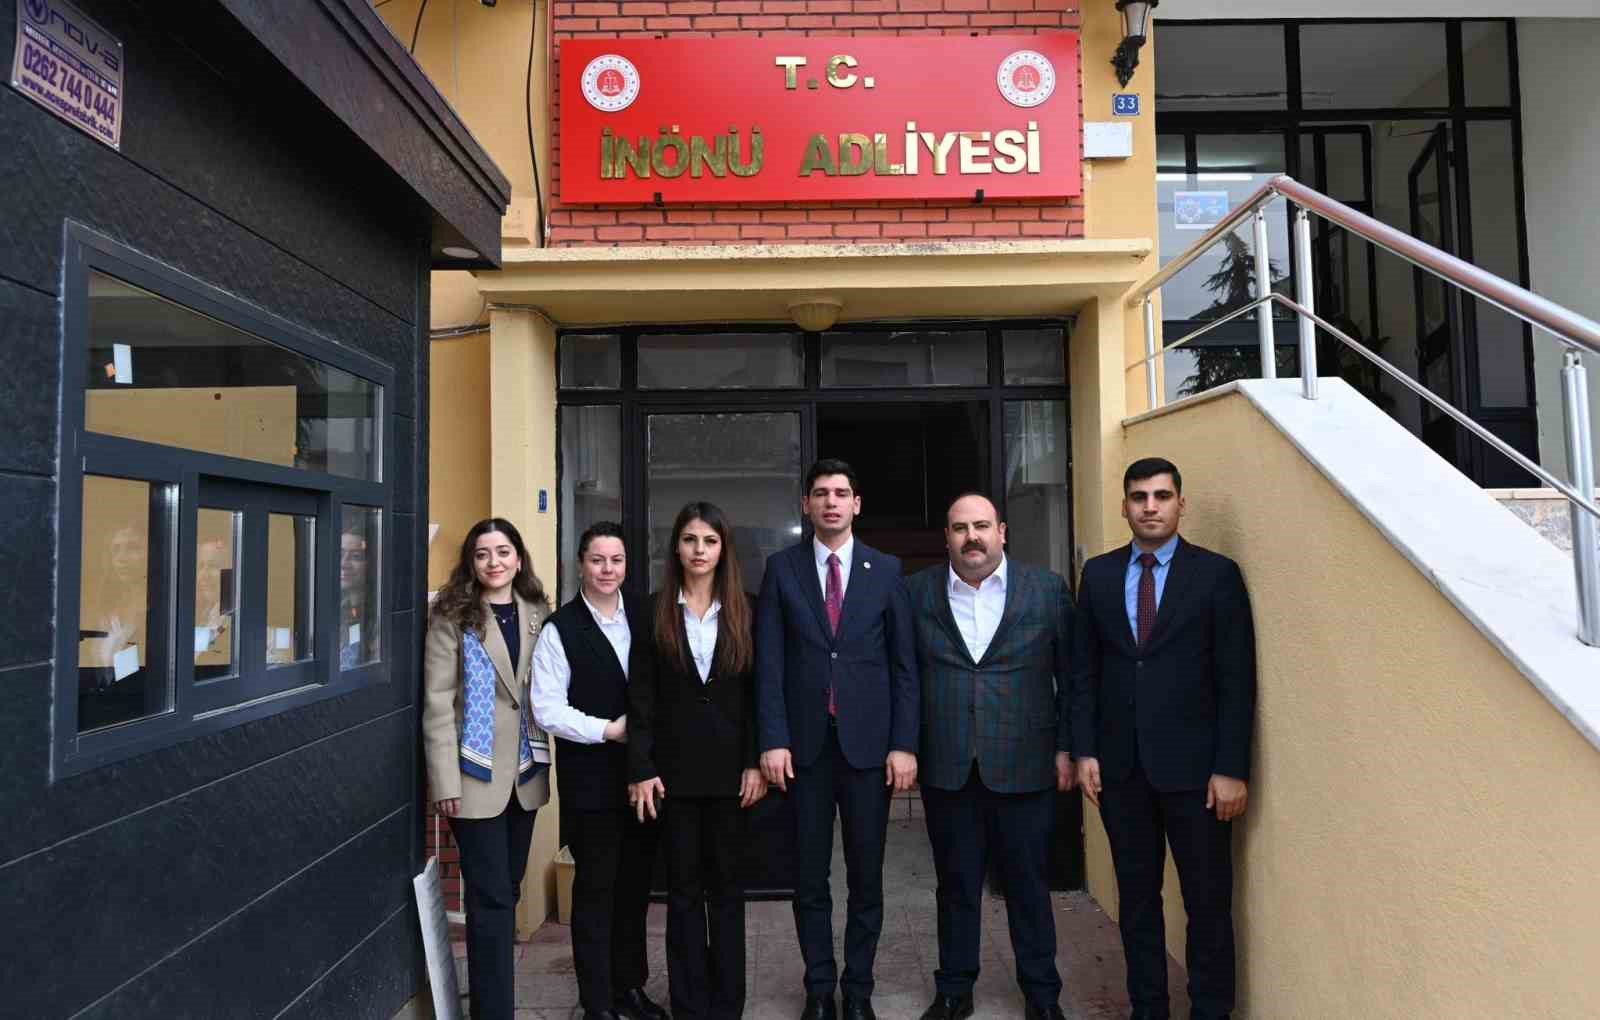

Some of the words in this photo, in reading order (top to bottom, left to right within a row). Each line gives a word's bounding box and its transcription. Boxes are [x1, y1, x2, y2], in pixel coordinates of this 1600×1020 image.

[23, 43, 58, 88] 0262
[60, 67, 82, 104] 744
[84, 84, 92, 109] 0
[94, 93, 115, 126] 444
[775, 55, 875, 89] T.C.
[1117, 97, 1136, 110] 33
[600, 125, 764, 179] İNÖNÜ
[798, 120, 1041, 177] ADLİYESİ
